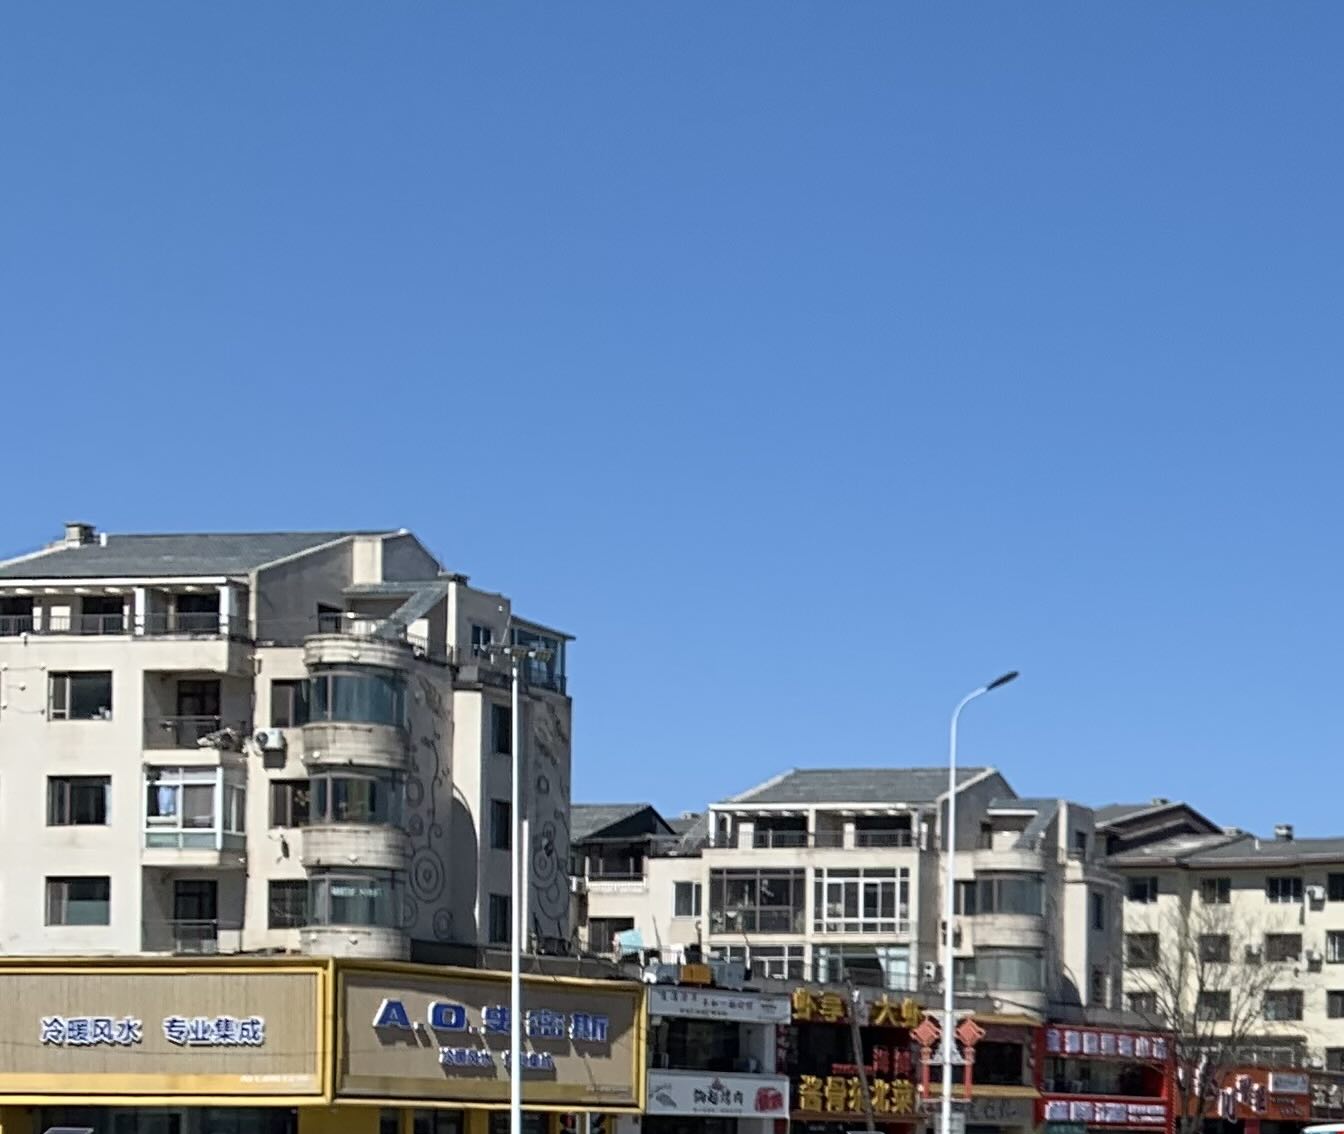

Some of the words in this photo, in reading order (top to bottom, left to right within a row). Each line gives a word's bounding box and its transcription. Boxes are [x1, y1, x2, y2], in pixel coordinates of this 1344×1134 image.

[40, 1014, 143, 1046] 冷暖风水
[162, 1015, 266, 1047] 专业集成
